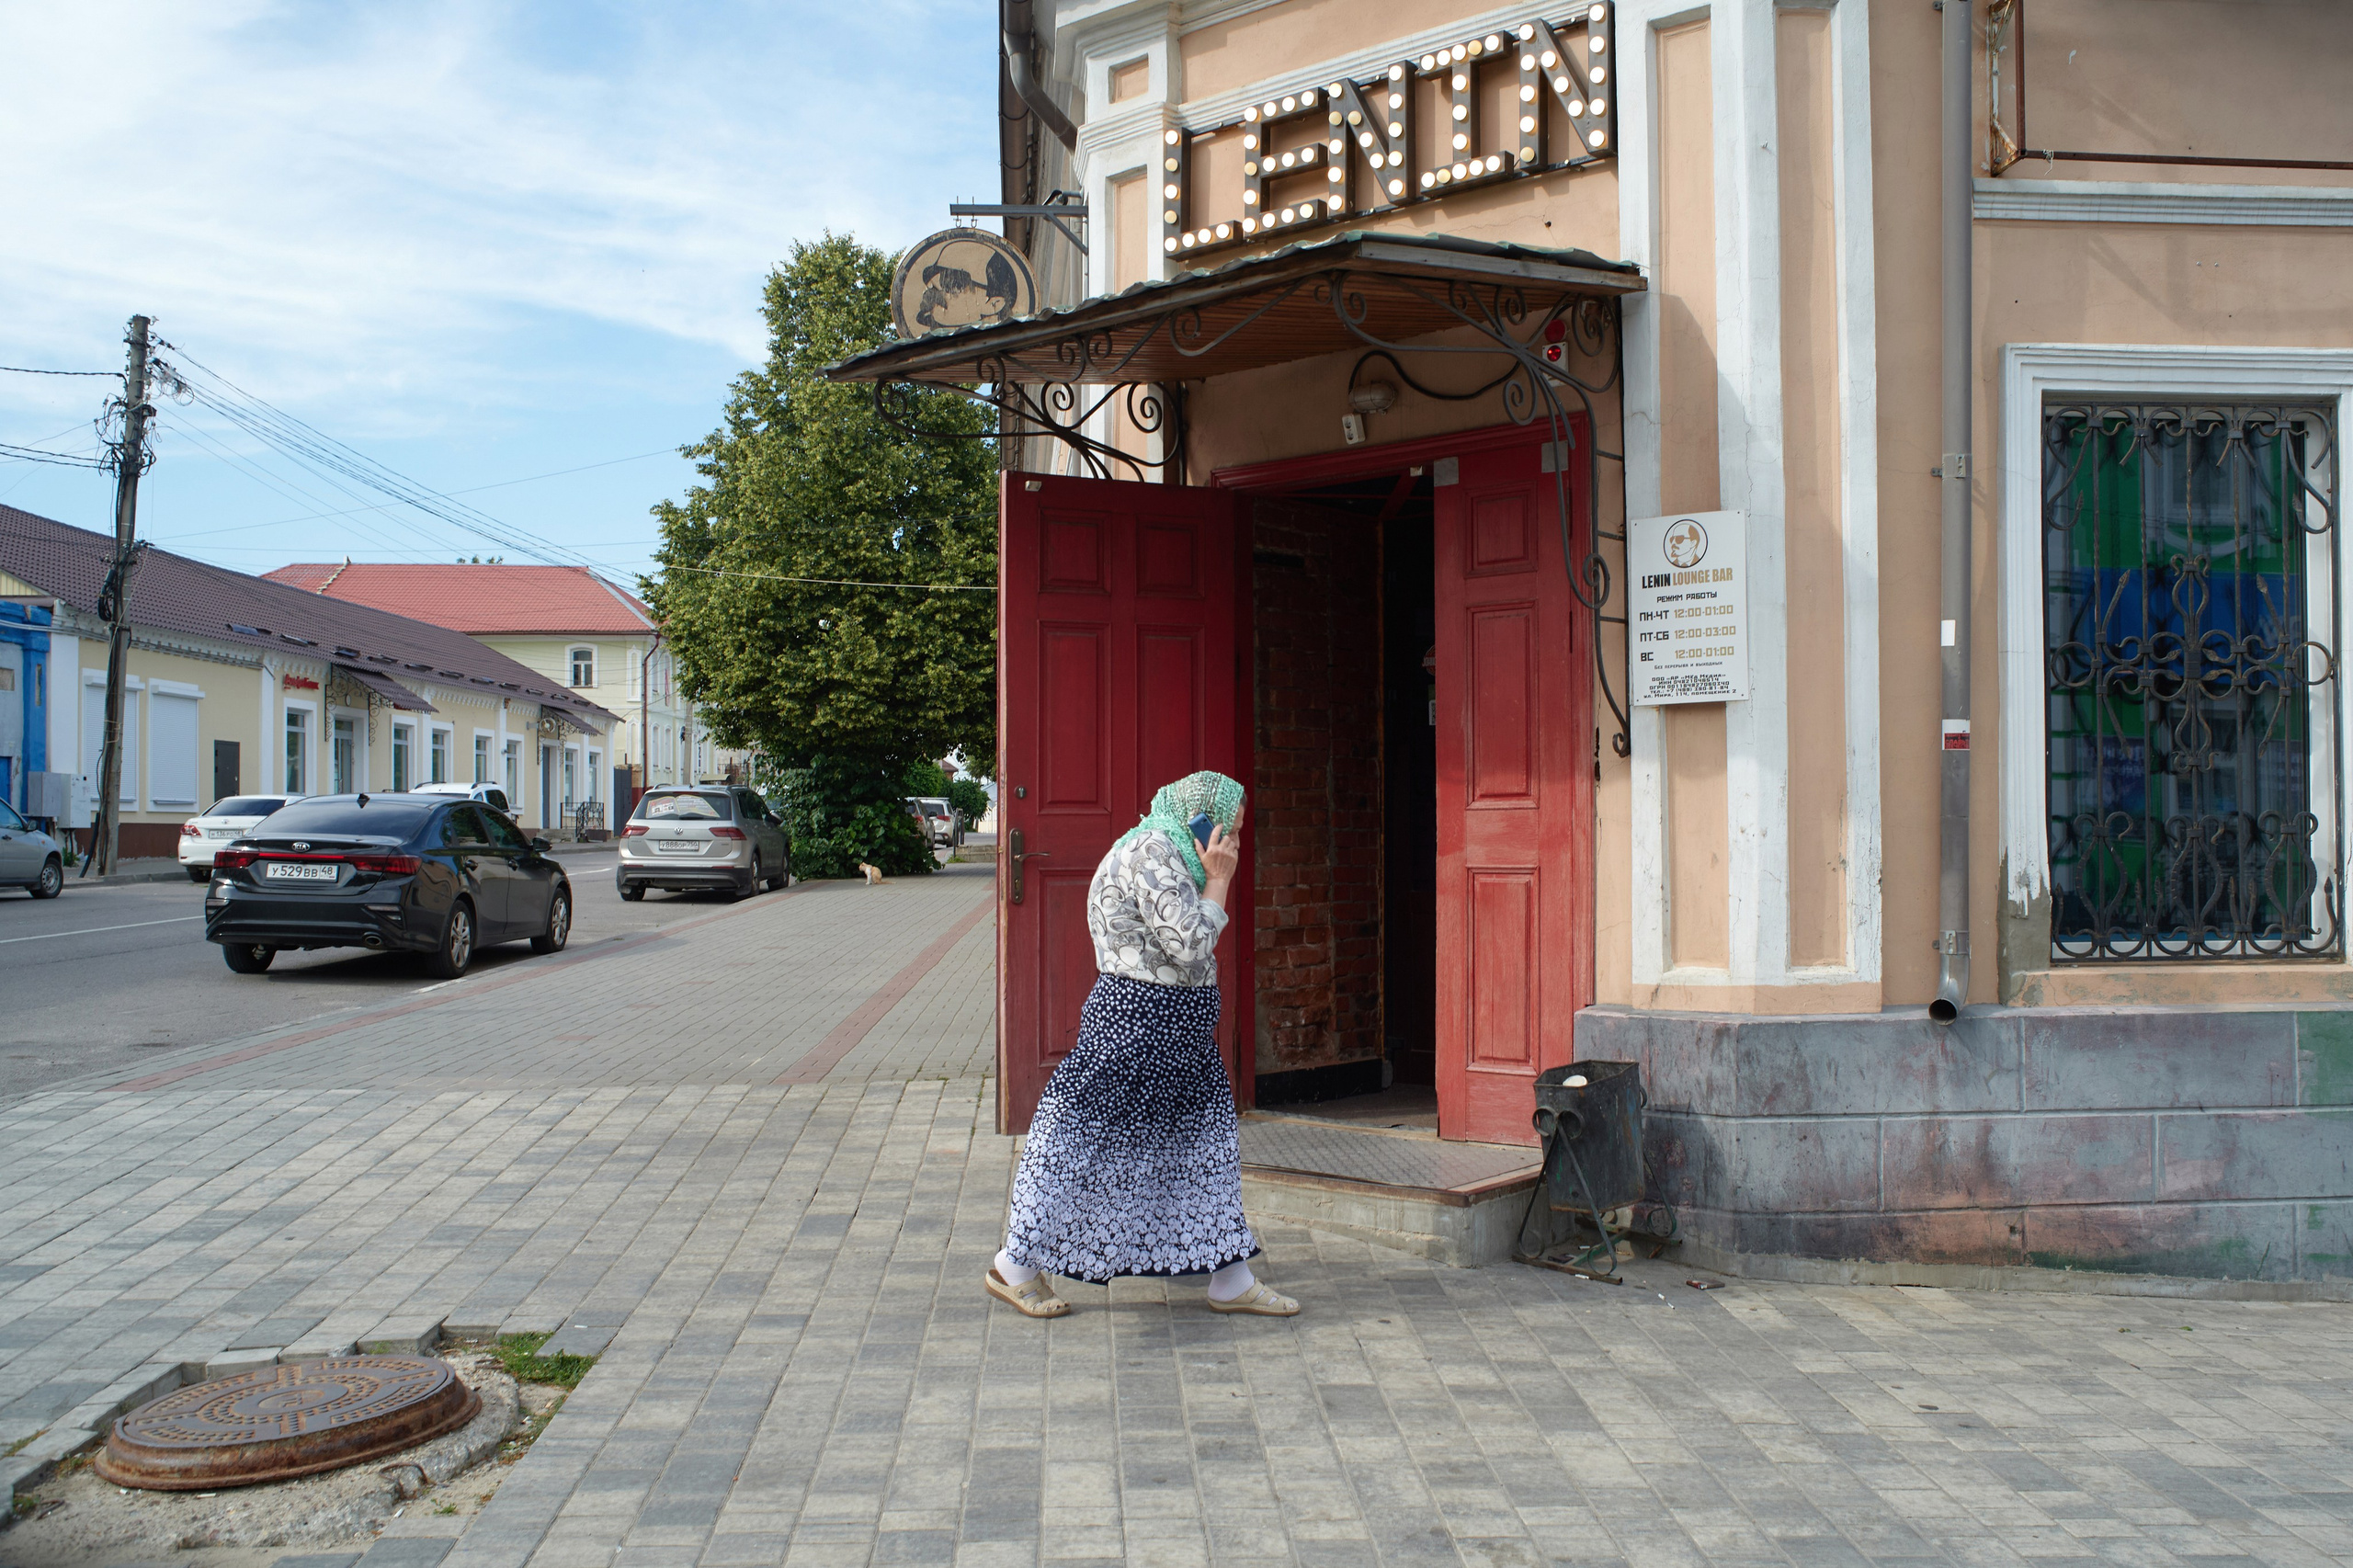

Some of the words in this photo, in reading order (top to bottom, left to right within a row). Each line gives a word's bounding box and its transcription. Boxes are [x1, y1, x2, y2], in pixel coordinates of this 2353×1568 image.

[1164, 0, 1618, 260] LENIN
[1642, 574, 1671, 589] LENIN
[1673, 570, 1710, 585] LOUNGE
[1712, 567, 1733, 583] BAR
[1656, 594, 1683, 603] РЕЖИМ
[1686, 592, 1717, 600] РАБОТЫ
[1640, 610, 1669, 621] ПН-ЧТ
[1674, 605, 1733, 618] 12:00-01:00
[1640, 631, 1669, 642] ПТ-СБ
[1675, 625, 1735, 639] 12:00-03:00
[1641, 652, 1654, 662] ВС
[1675, 645, 1734, 659] 12:00-01:00
[293, 843, 308, 851] KIA
